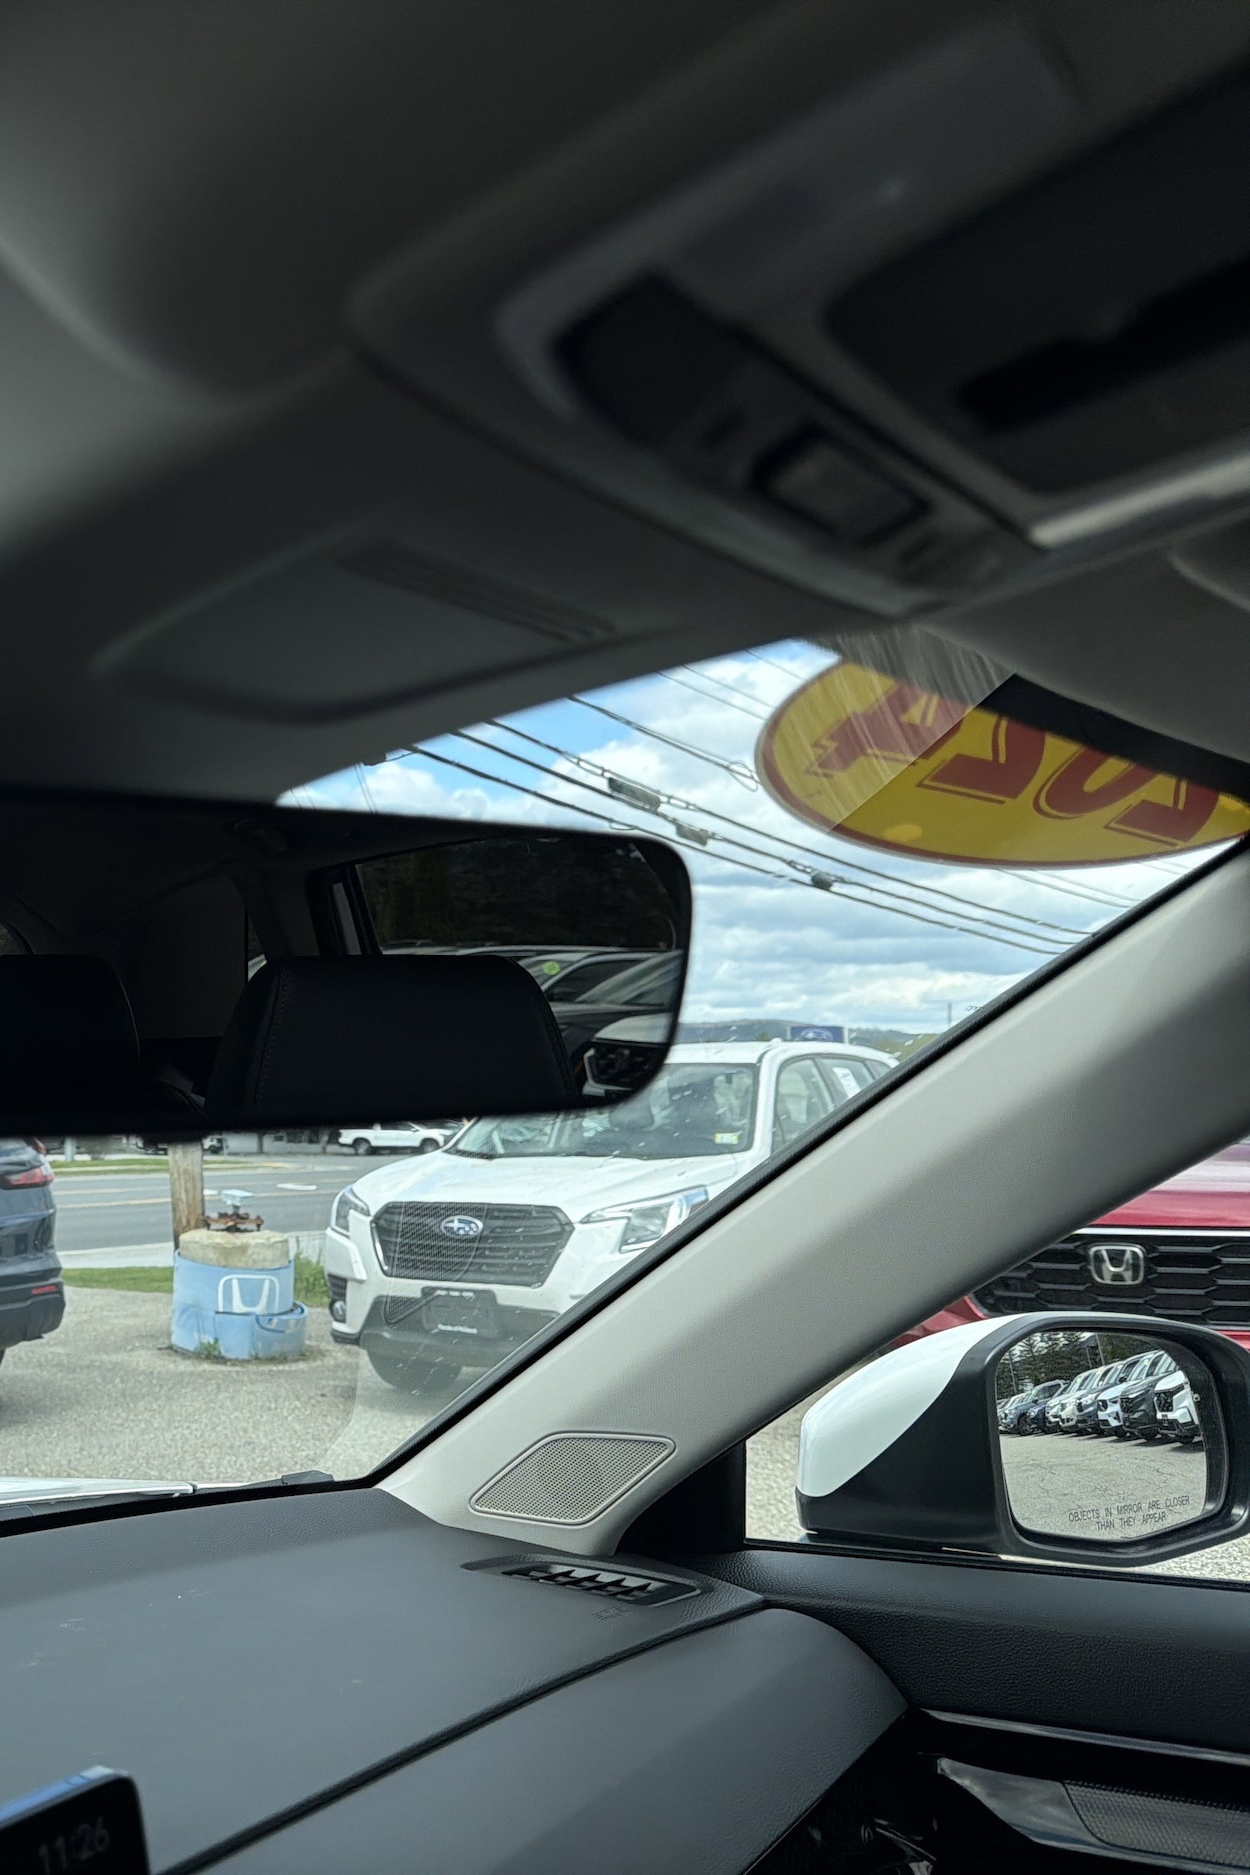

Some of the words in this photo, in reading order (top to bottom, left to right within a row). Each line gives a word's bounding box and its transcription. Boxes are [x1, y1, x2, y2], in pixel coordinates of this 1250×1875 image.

[1068, 1509, 1100, 1522] OBJECTS
[1104, 1506, 1112, 1518] IN
[1116, 1502, 1142, 1515] MIRROR
[1148, 1499, 1161, 1511] ARE
[1165, 1495, 1190, 1508] CLOSER
[1096, 1519, 1115, 1531] THAN
[1120, 1516, 1137, 1528] THEY
[1141, 1512, 1166, 1524] APPEAR
